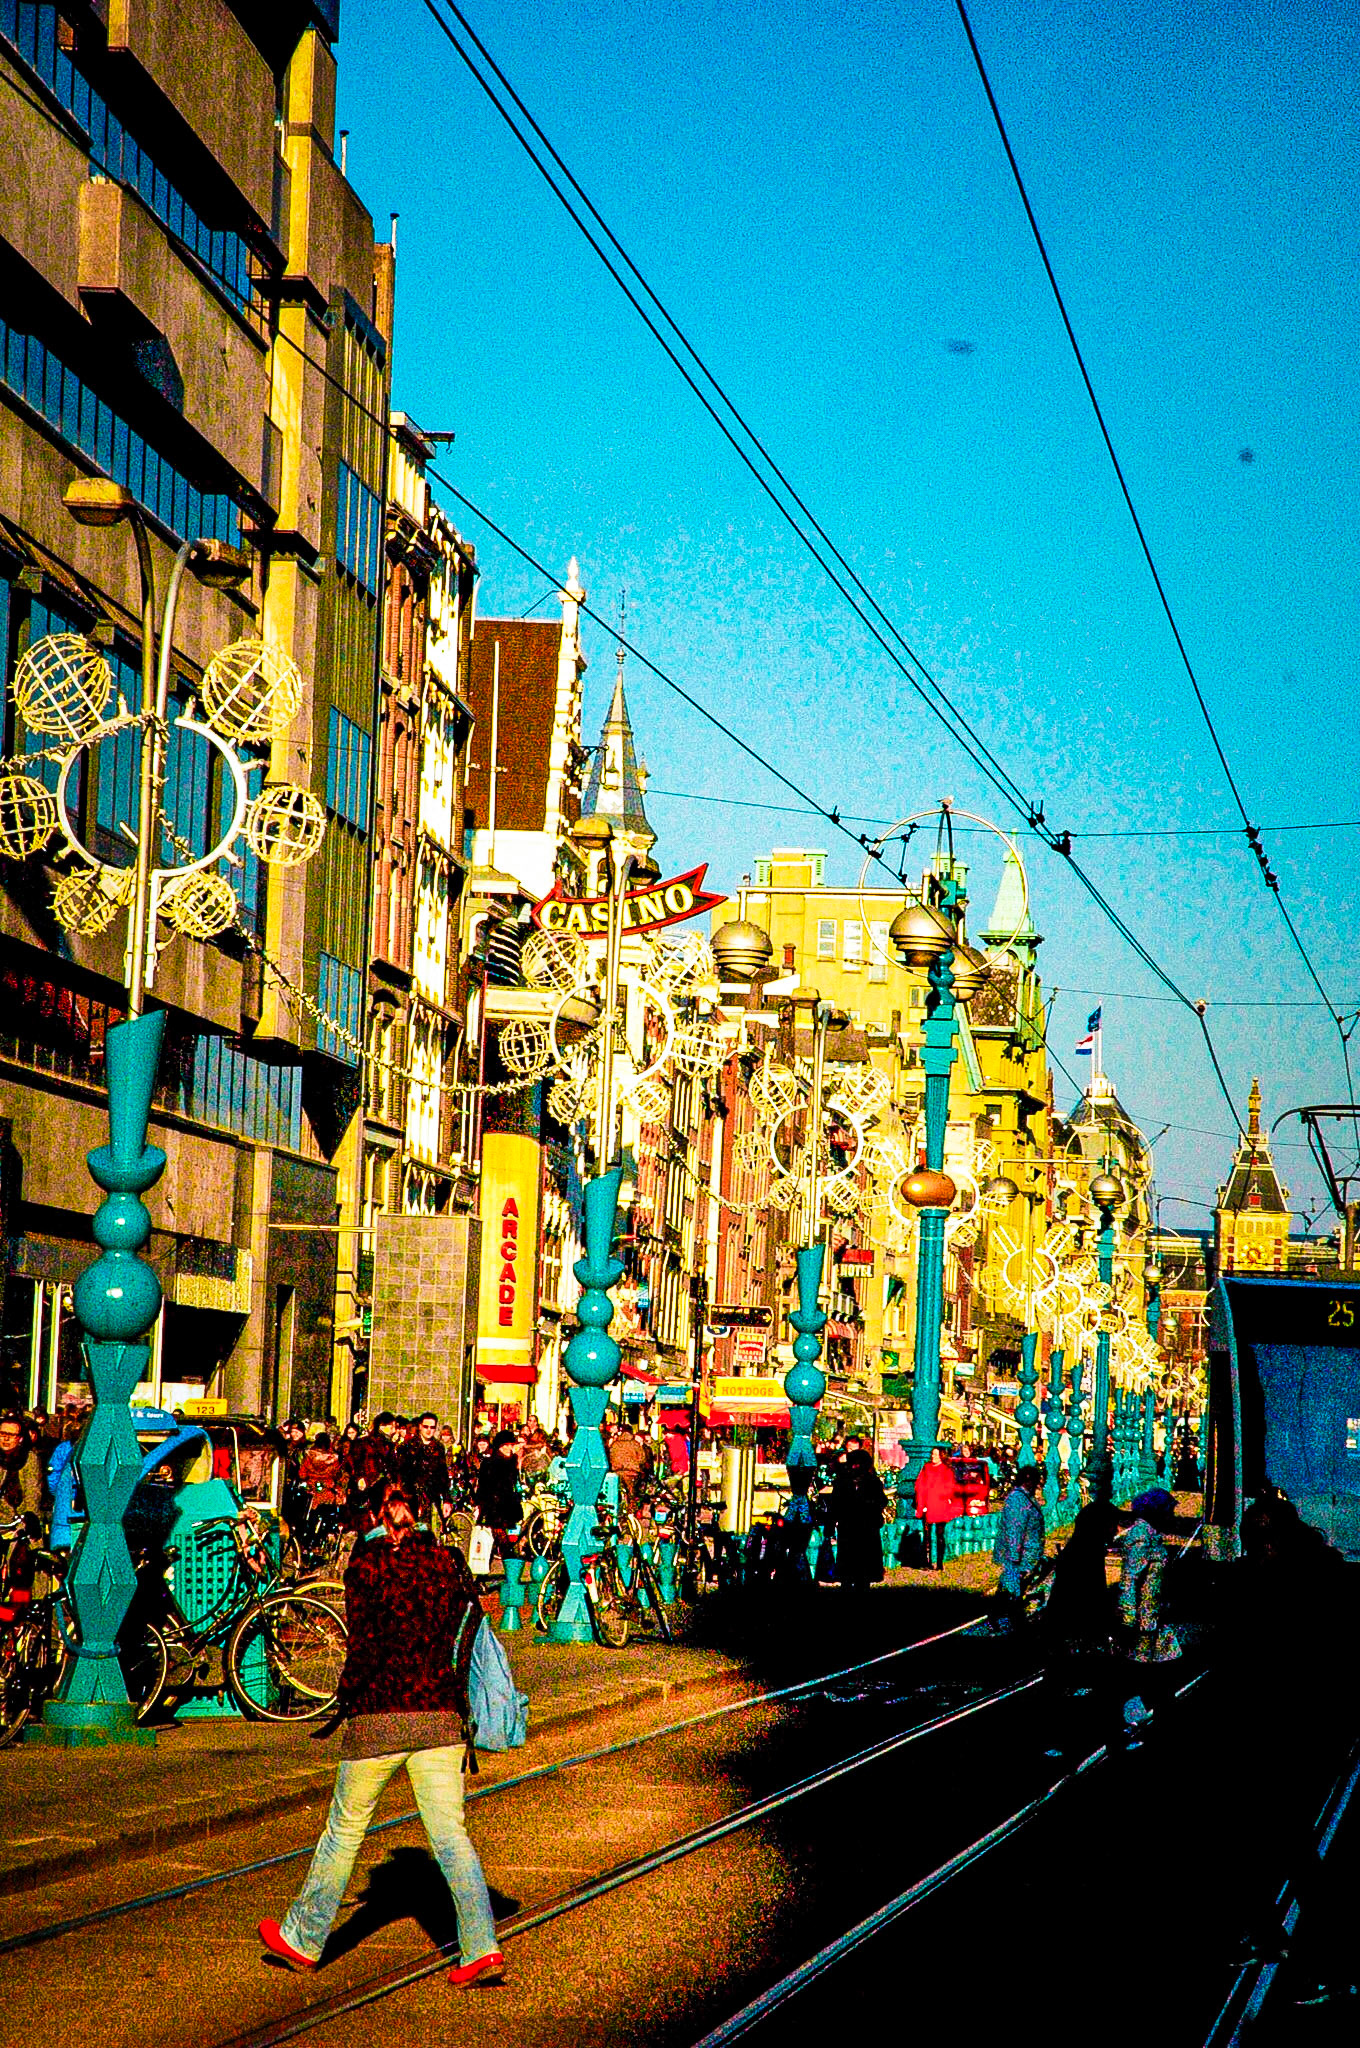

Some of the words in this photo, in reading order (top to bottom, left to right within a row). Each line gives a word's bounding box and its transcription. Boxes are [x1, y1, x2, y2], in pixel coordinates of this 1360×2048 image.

[540, 883, 694, 932] CASINO
[498, 1197, 519, 1327] ARCADE
[840, 1263, 873, 1278] HOTEL
[1328, 1300, 1355, 1327] 25
[721, 1386, 775, 1397] HOTDOGS
[196, 1406, 215, 1414] 123
